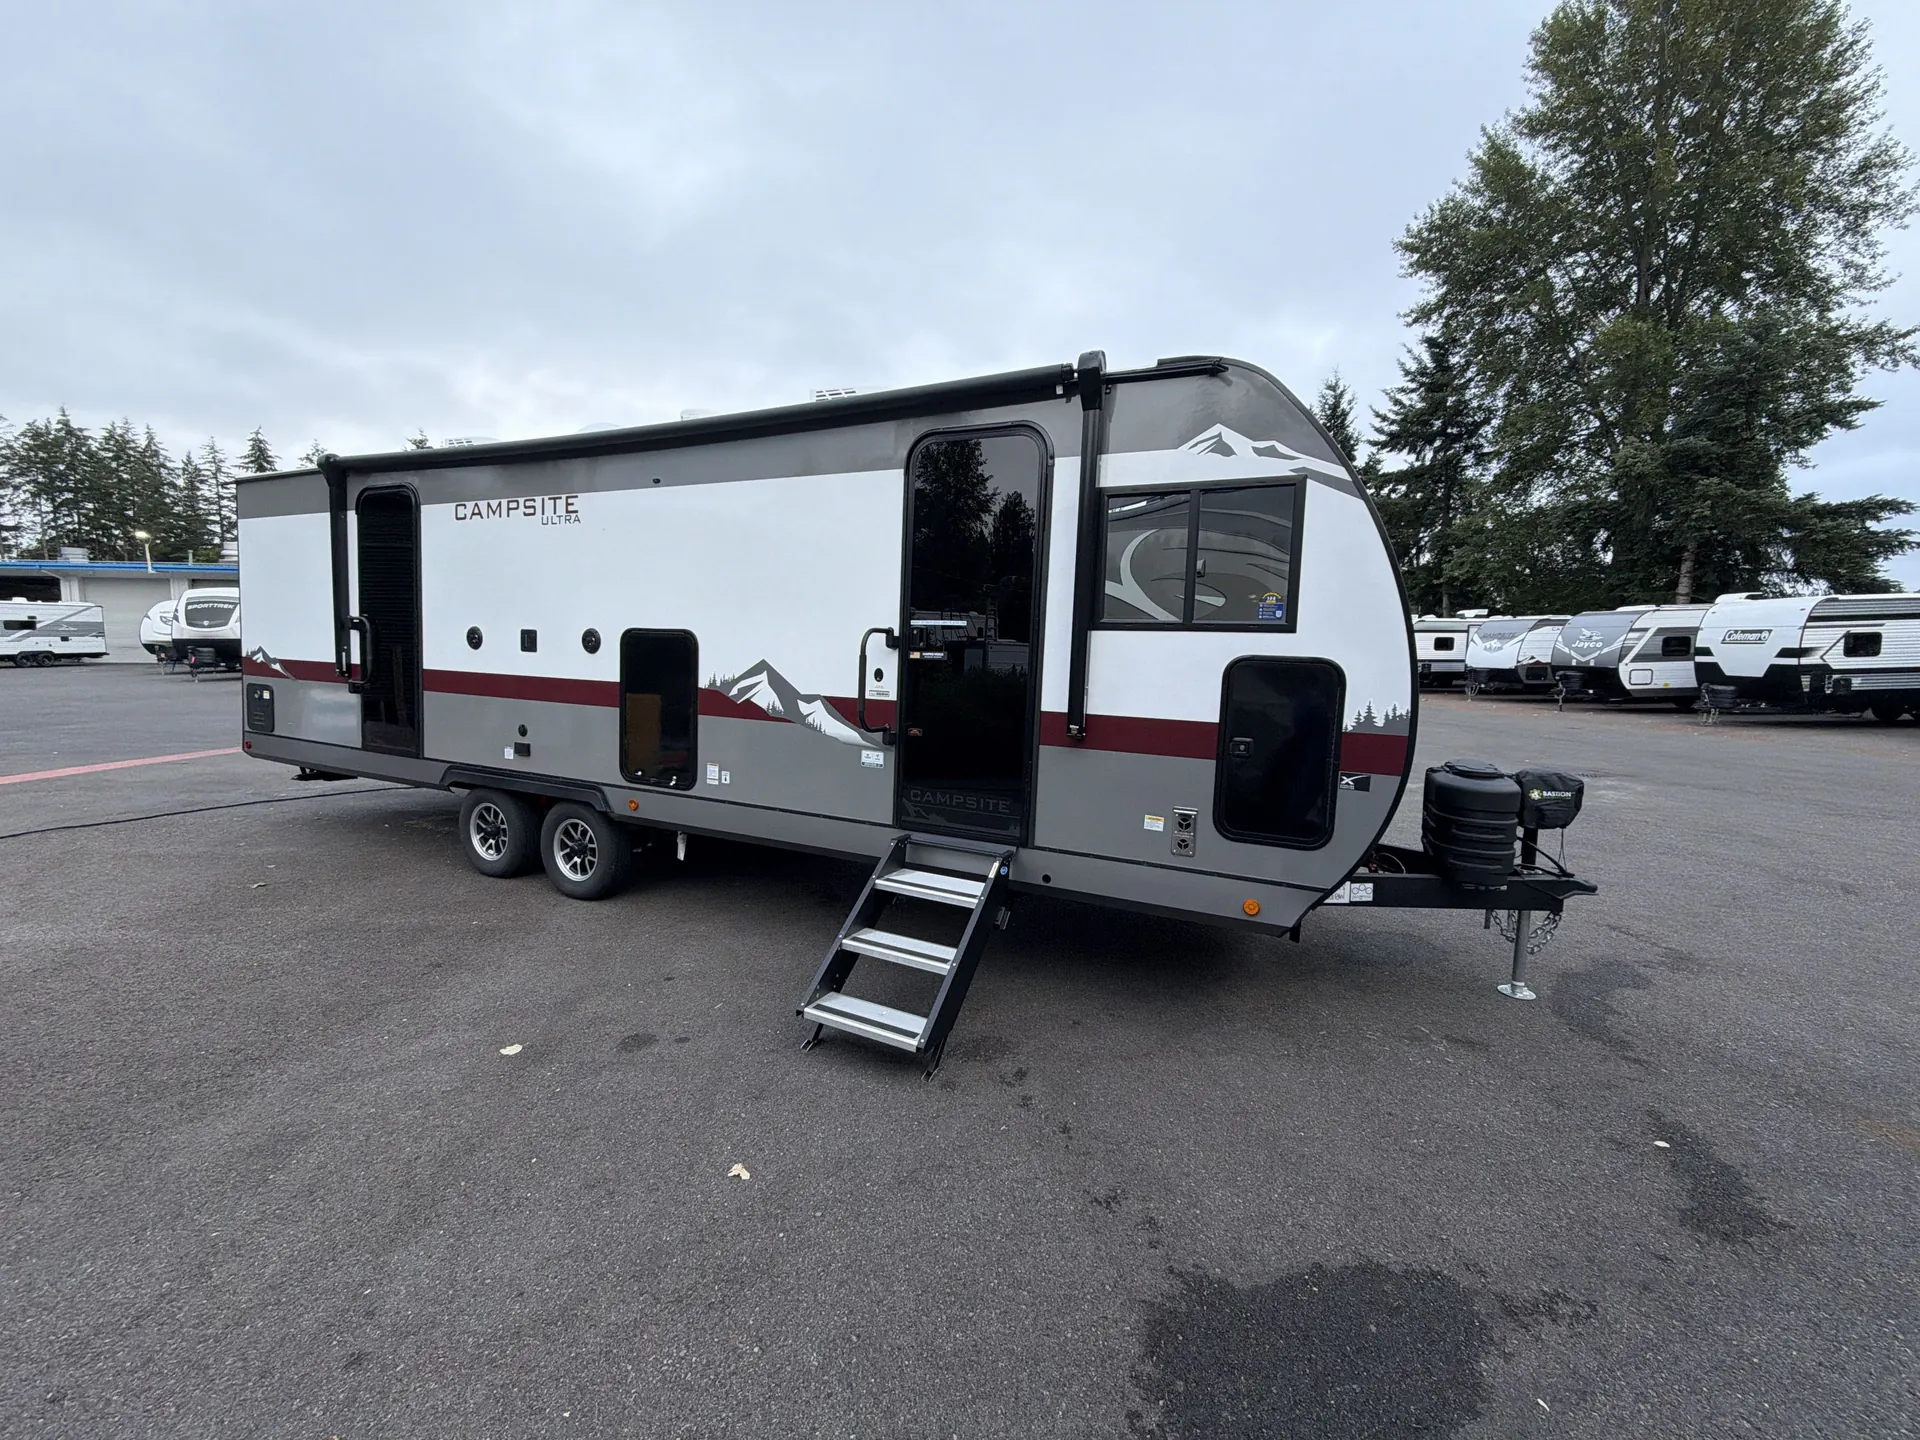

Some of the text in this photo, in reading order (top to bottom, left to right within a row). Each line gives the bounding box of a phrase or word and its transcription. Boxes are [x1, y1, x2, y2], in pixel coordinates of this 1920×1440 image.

[455, 495, 579, 521] CAMPSITE
[541, 514, 581, 526] ULTRA
[186, 602, 235, 610] SPORTTREK
[1725, 630, 1761, 641] Coleman
[1572, 640, 1603, 649] Jayco
[910, 789, 1010, 813] CAMPSITE
